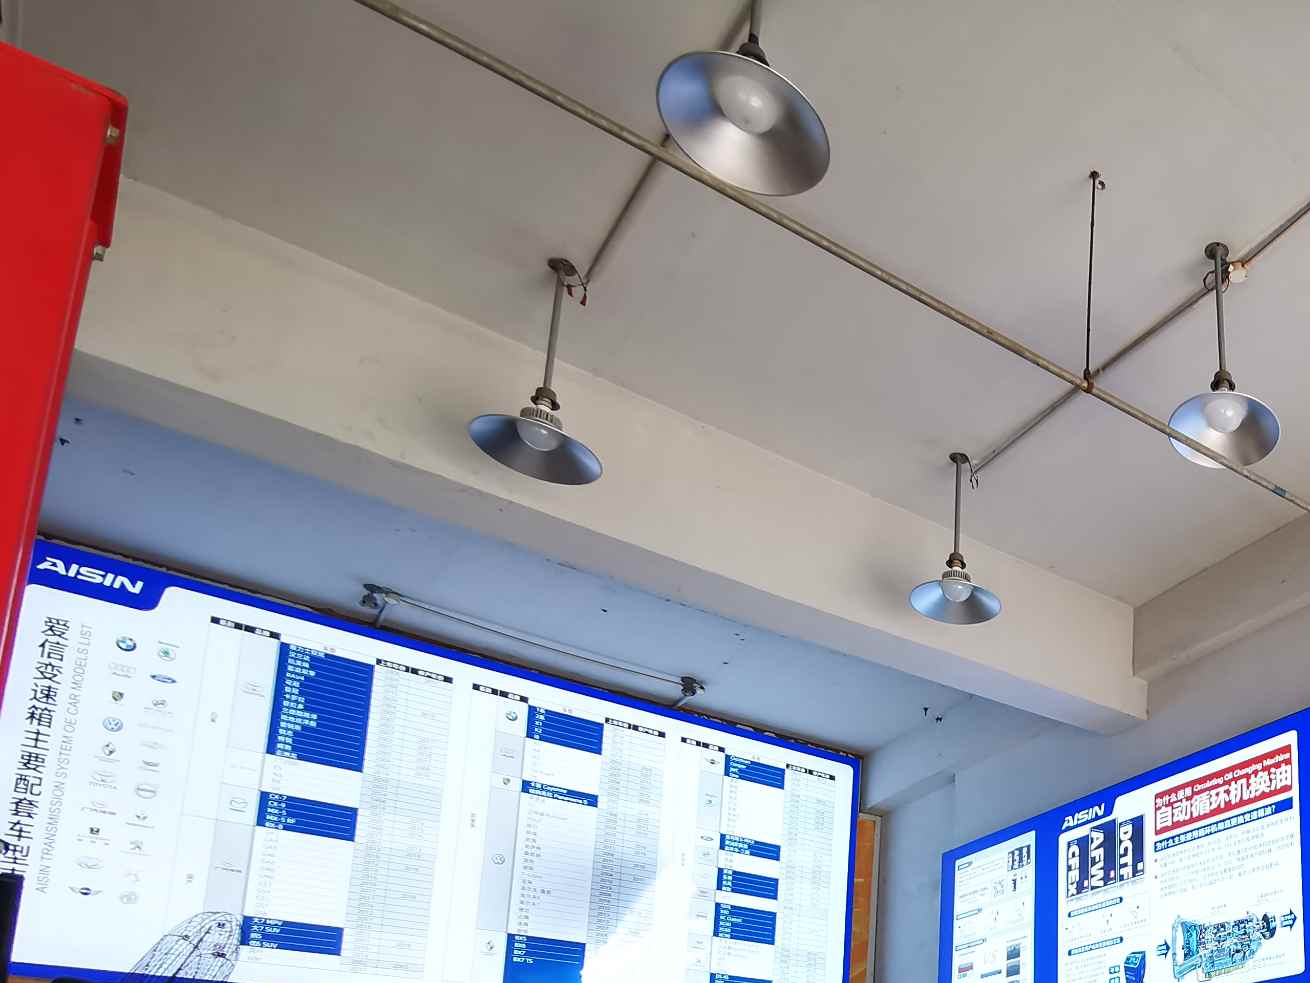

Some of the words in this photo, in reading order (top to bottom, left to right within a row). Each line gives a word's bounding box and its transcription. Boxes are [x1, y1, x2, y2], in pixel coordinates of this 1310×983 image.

[36, 556, 144, 595] AISIN
[67, 690, 80, 715] CAR
[1062, 803, 1105, 830] AISIN
[1156, 764, 1292, 830] 自动循环机换油
[1090, 829, 1105, 888] AFW
[1119, 822, 1133, 881] DCTF
